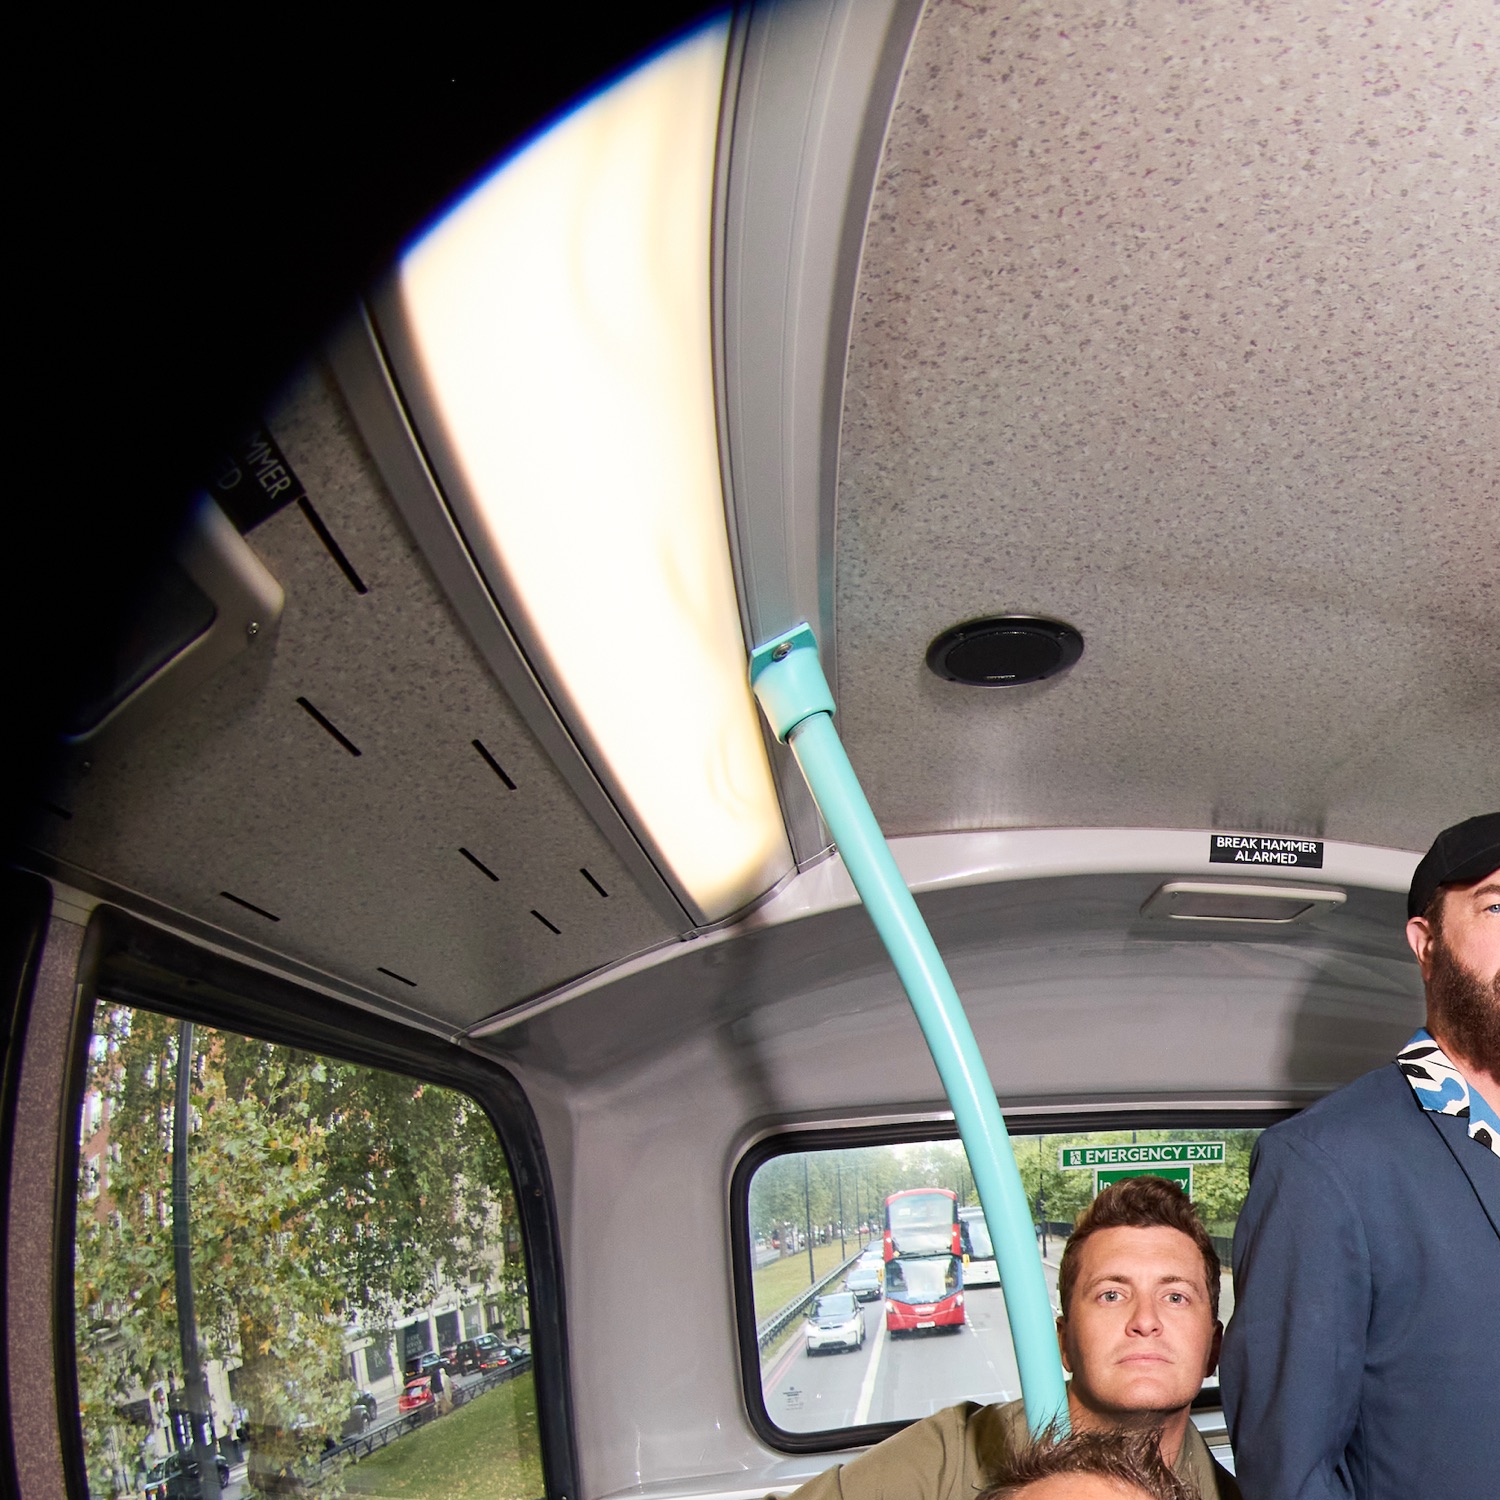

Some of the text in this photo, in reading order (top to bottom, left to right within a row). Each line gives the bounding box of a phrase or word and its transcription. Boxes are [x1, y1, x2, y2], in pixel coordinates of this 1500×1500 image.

[1216, 836, 1317, 853] BREAK HAMMER
[1234, 850, 1298, 865] ALARMED
[1086, 1145, 1221, 1164] EMERGENCY EXIT
